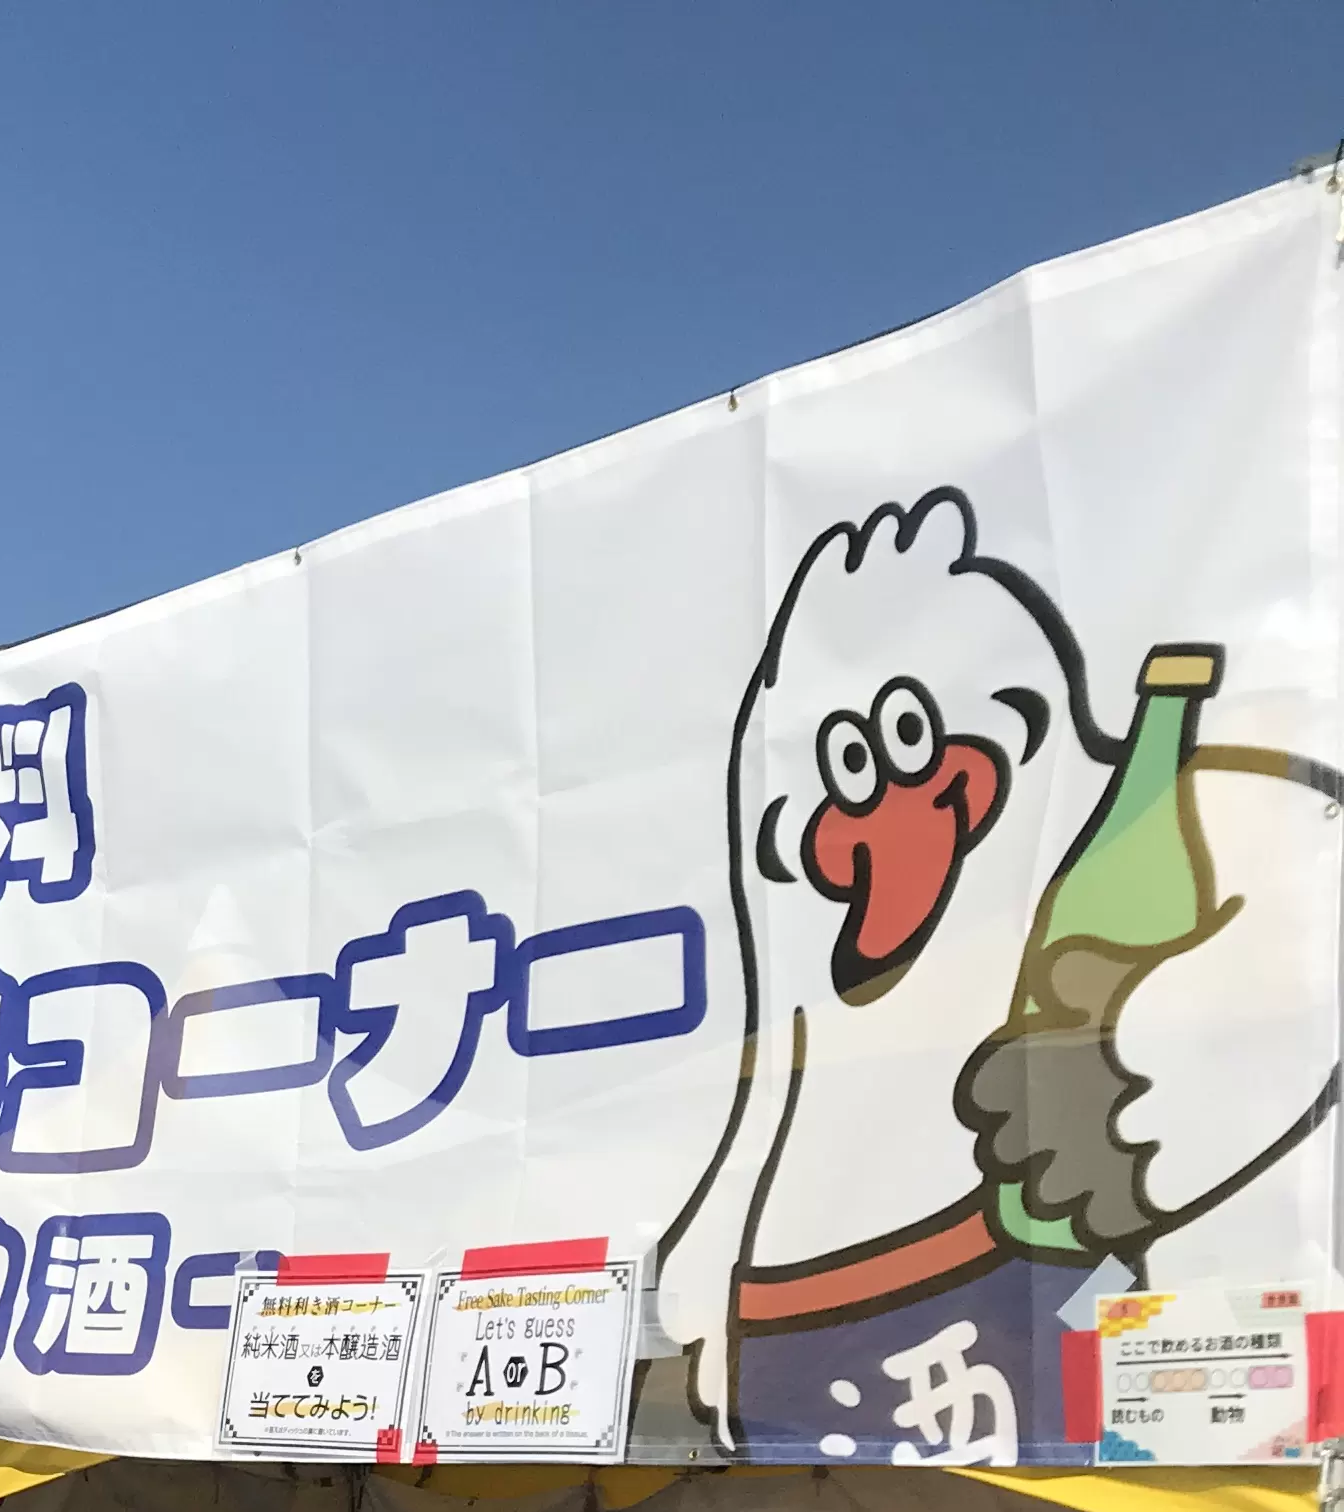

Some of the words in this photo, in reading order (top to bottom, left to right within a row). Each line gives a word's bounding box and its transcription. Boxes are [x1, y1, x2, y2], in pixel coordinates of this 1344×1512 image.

[261, 1295, 396, 1316] 無料利き酒コーナー
[458, 1290, 483, 1309] Free
[487, 1288, 513, 1308] Sake
[516, 1286, 561, 1309] Tasting
[564, 1285, 609, 1305] Corner
[476, 1316, 515, 1340] Let's
[524, 1316, 575, 1339] guess
[241, 1331, 403, 1361] 純米酒又は本醸造酒
[1120, 1332, 1282, 1356] ここで飲めるお酒の種類
[466, 1344, 495, 1397] A
[507, 1360, 526, 1384] or
[535, 1342, 570, 1395] B
[466, 1401, 484, 1426] by
[495, 1400, 571, 1425] drinking
[1112, 1407, 1165, 1424] 読むもの
[1210, 1406, 1246, 1424] 動物
